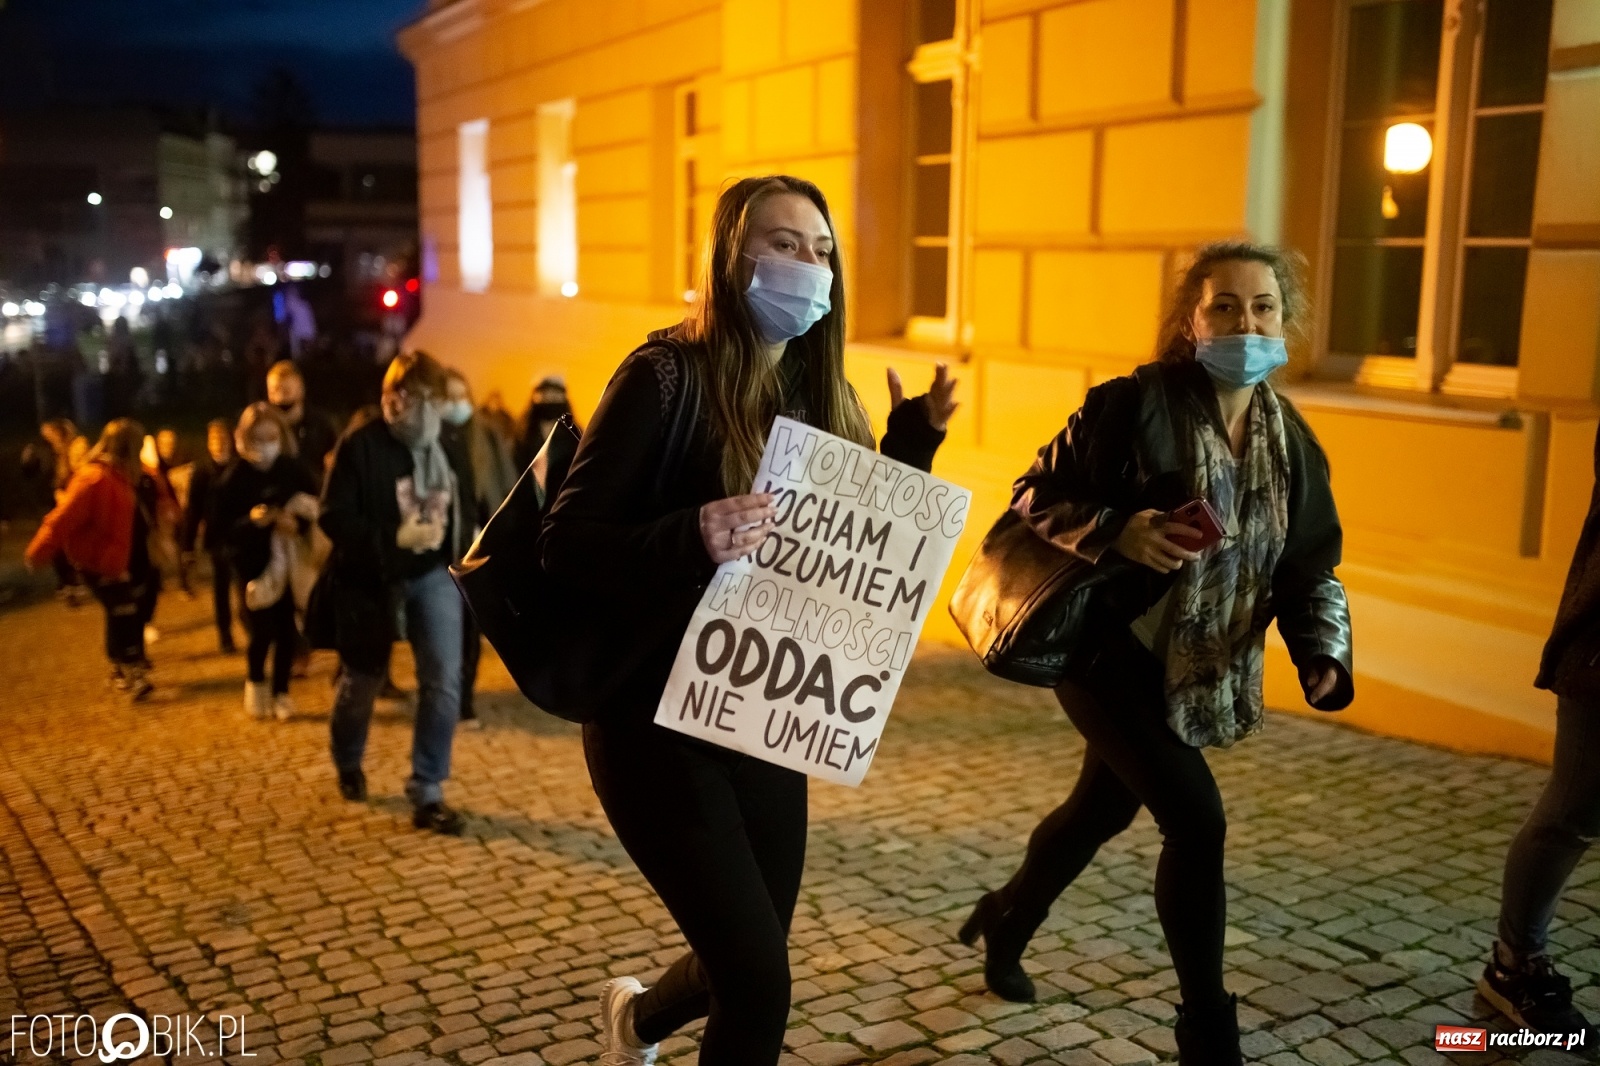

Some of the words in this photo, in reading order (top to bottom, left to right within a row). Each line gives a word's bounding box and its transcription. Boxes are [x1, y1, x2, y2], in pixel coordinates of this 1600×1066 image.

[737, 530, 927, 622] OZUMIEM
[909, 535, 927, 571] I
[679, 680, 744, 732] NIE
[763, 708, 878, 772] UMIEM
